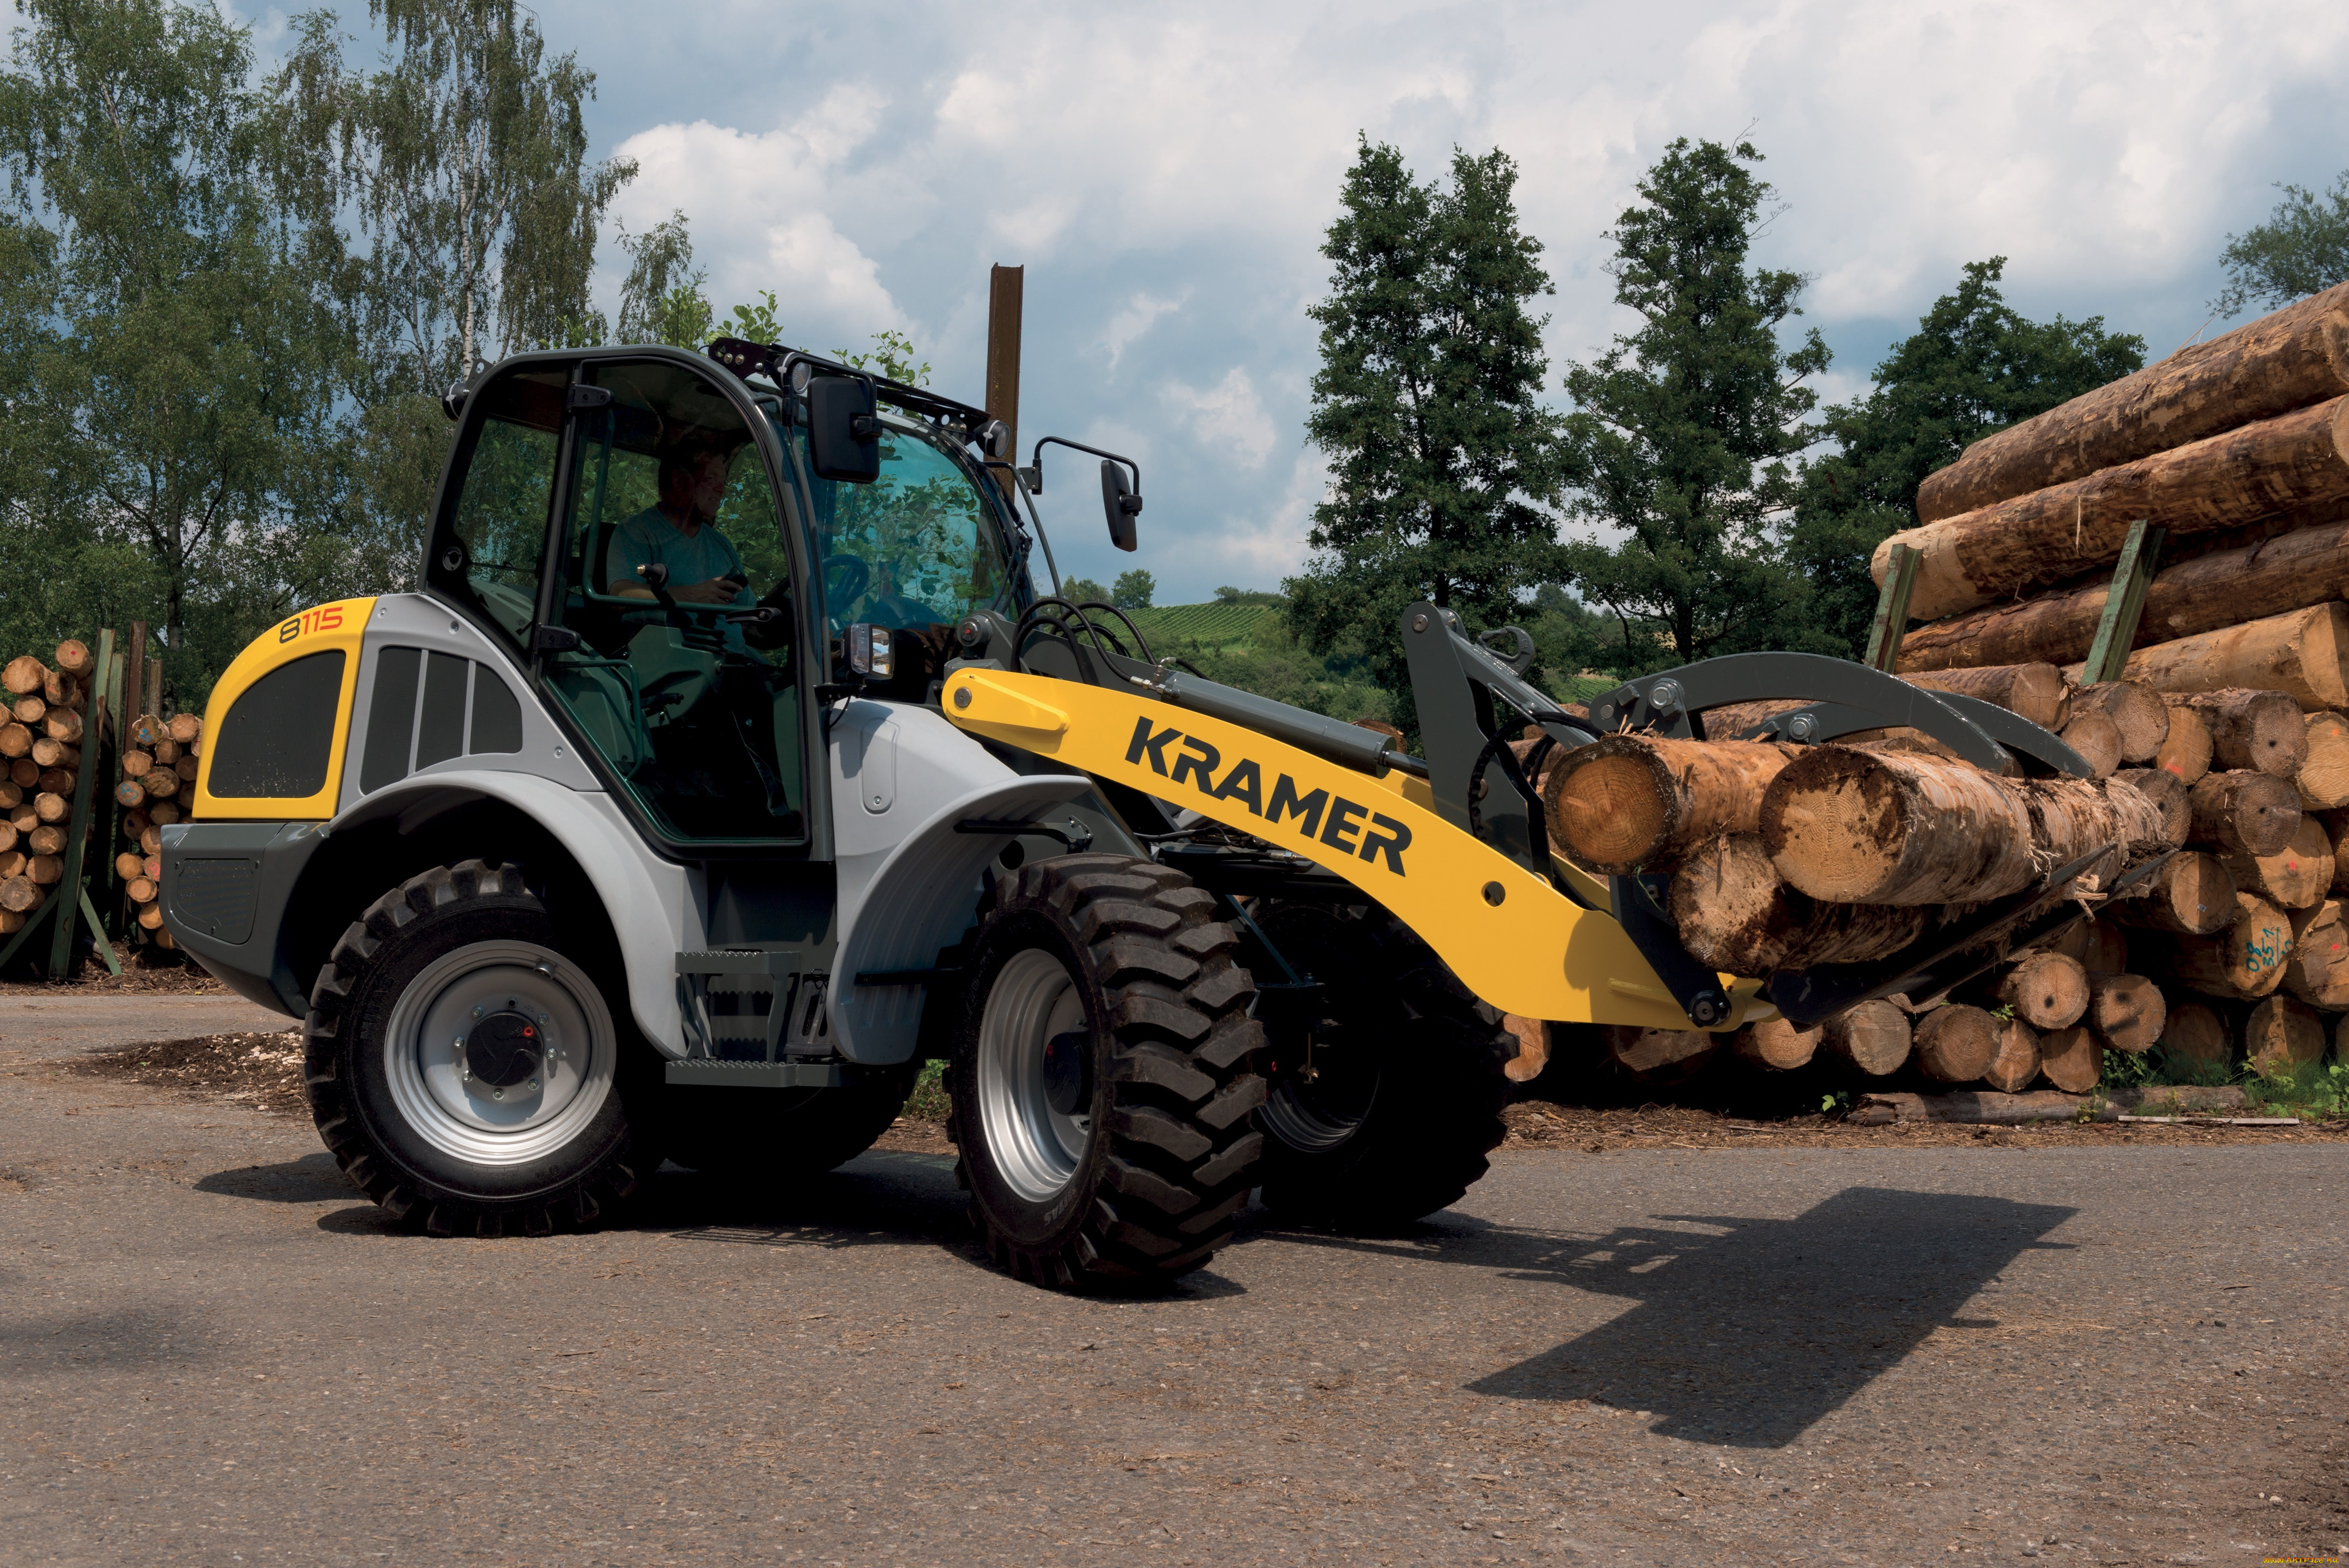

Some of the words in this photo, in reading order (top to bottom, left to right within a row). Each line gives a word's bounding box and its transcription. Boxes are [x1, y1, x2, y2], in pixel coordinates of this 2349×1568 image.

[279, 607, 343, 643] 8115
[1125, 716, 1412, 877] KRAMER
[360, 976, 395, 1041] MITAS
